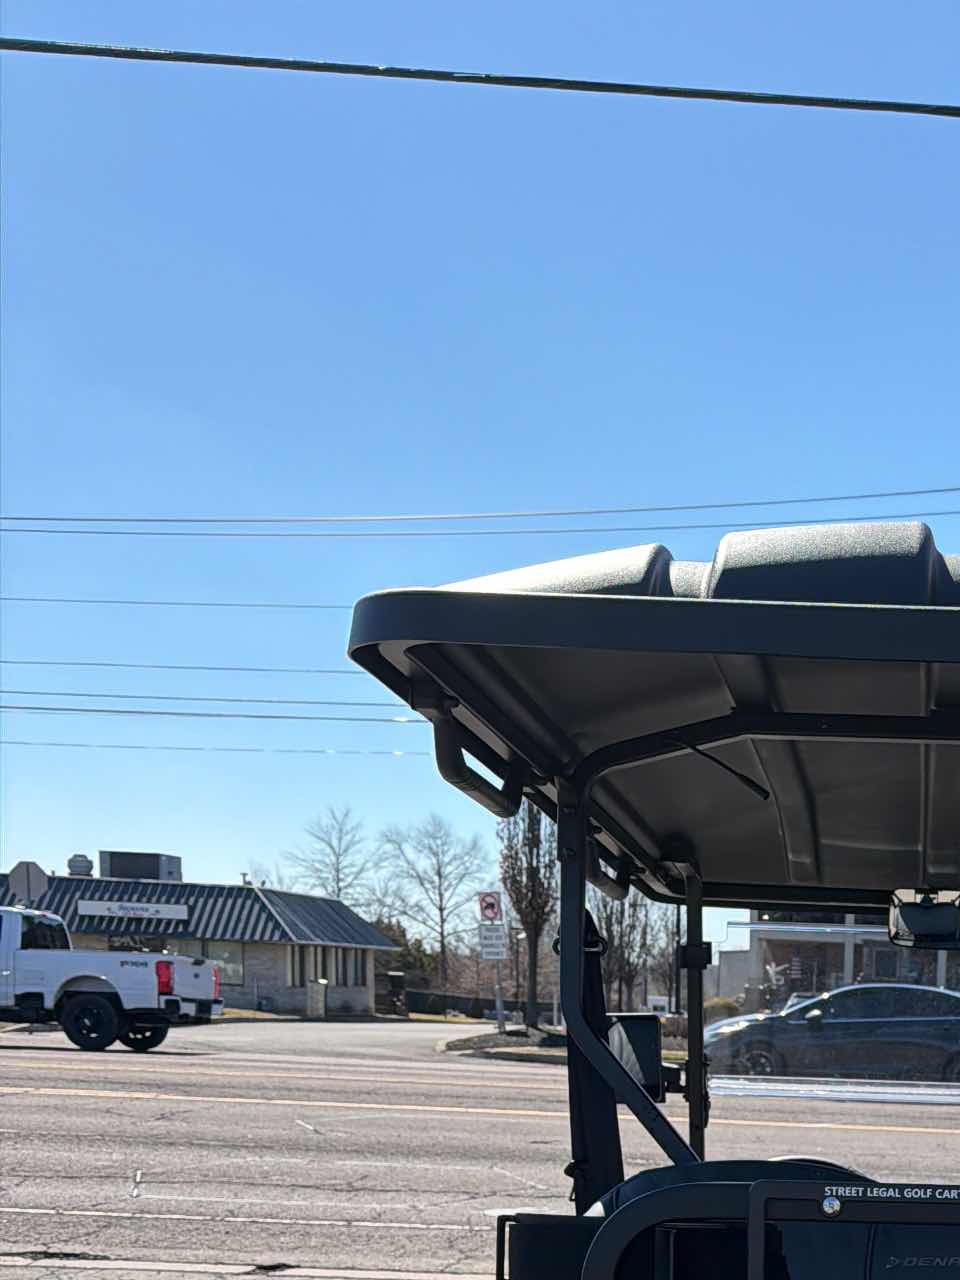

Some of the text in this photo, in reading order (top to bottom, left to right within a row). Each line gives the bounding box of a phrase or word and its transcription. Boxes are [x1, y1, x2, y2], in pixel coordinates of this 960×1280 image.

[824, 1186, 864, 1197] STREET
[867, 1187, 901, 1198] LEGAL
[904, 1188, 933, 1199] GOLF
